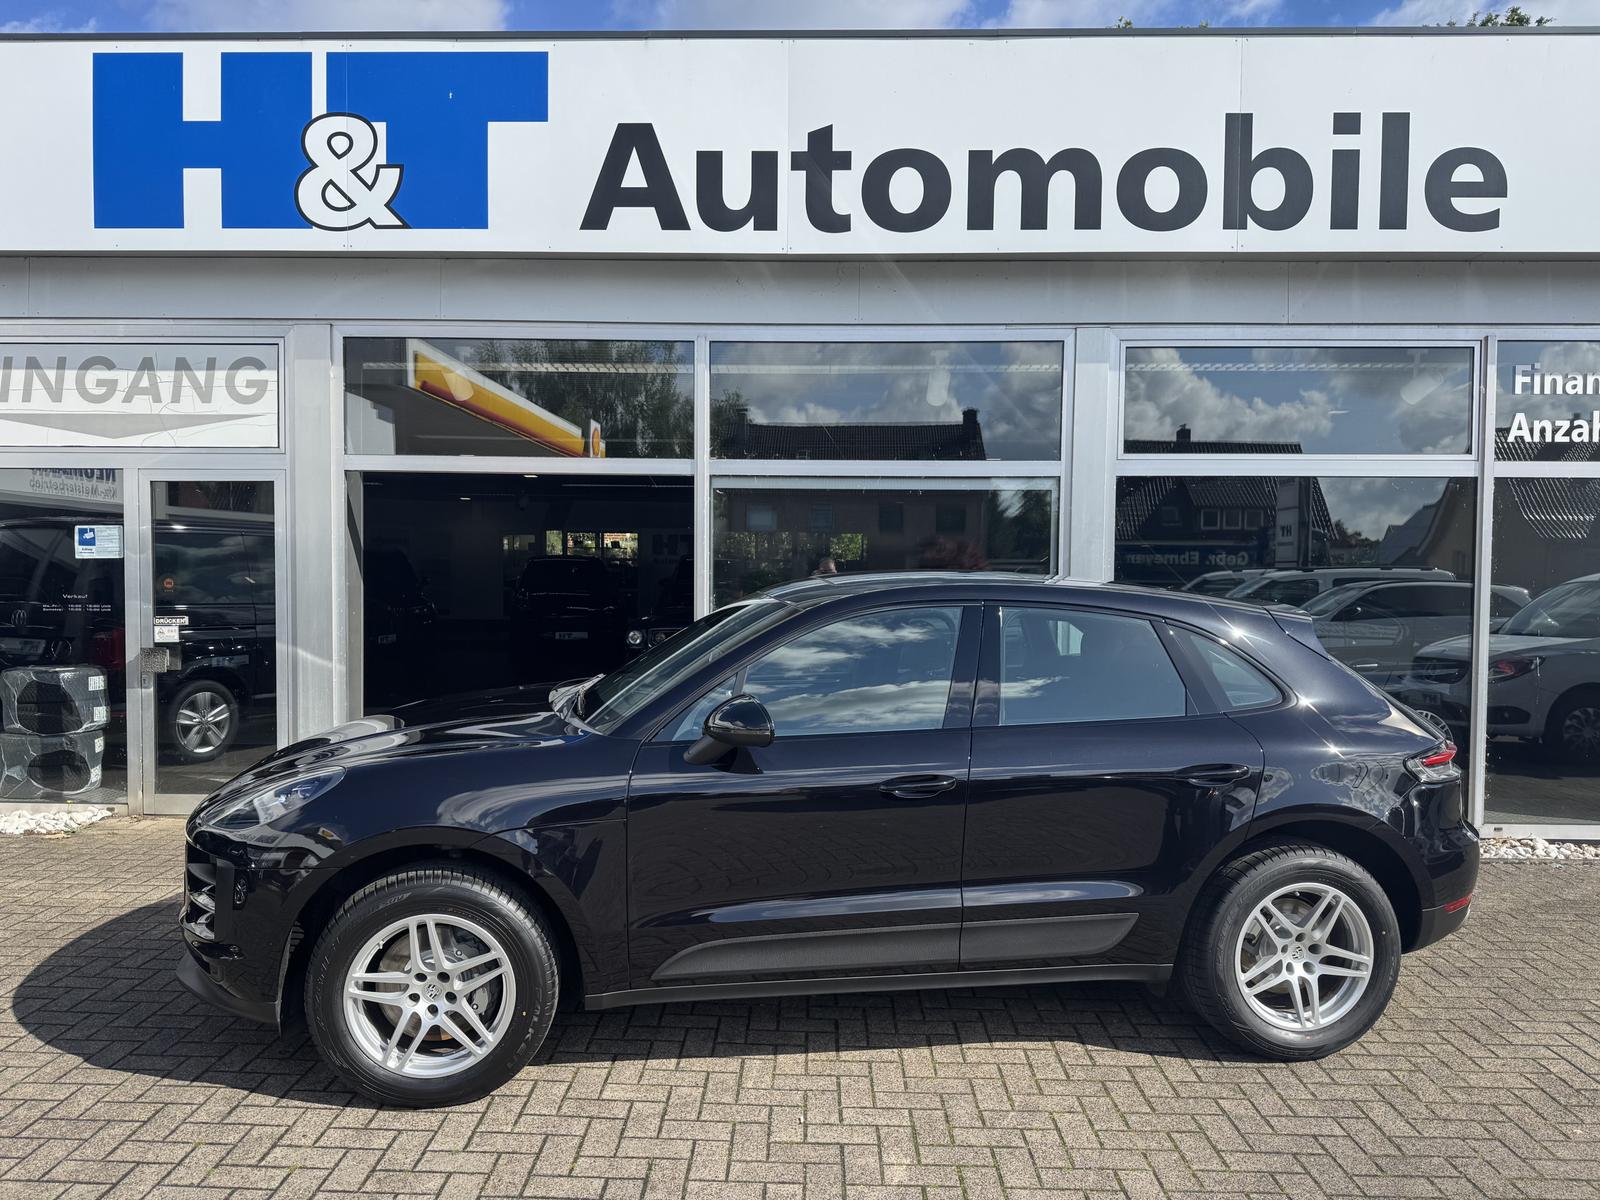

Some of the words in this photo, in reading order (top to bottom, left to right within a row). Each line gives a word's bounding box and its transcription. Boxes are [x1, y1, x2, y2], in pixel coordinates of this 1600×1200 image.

[92, 51, 549, 232] H&T
[579, 112, 1509, 233] Automobile
[0, 355, 269, 405] INGANG
[155, 617, 186, 625] DRÜCKEN
